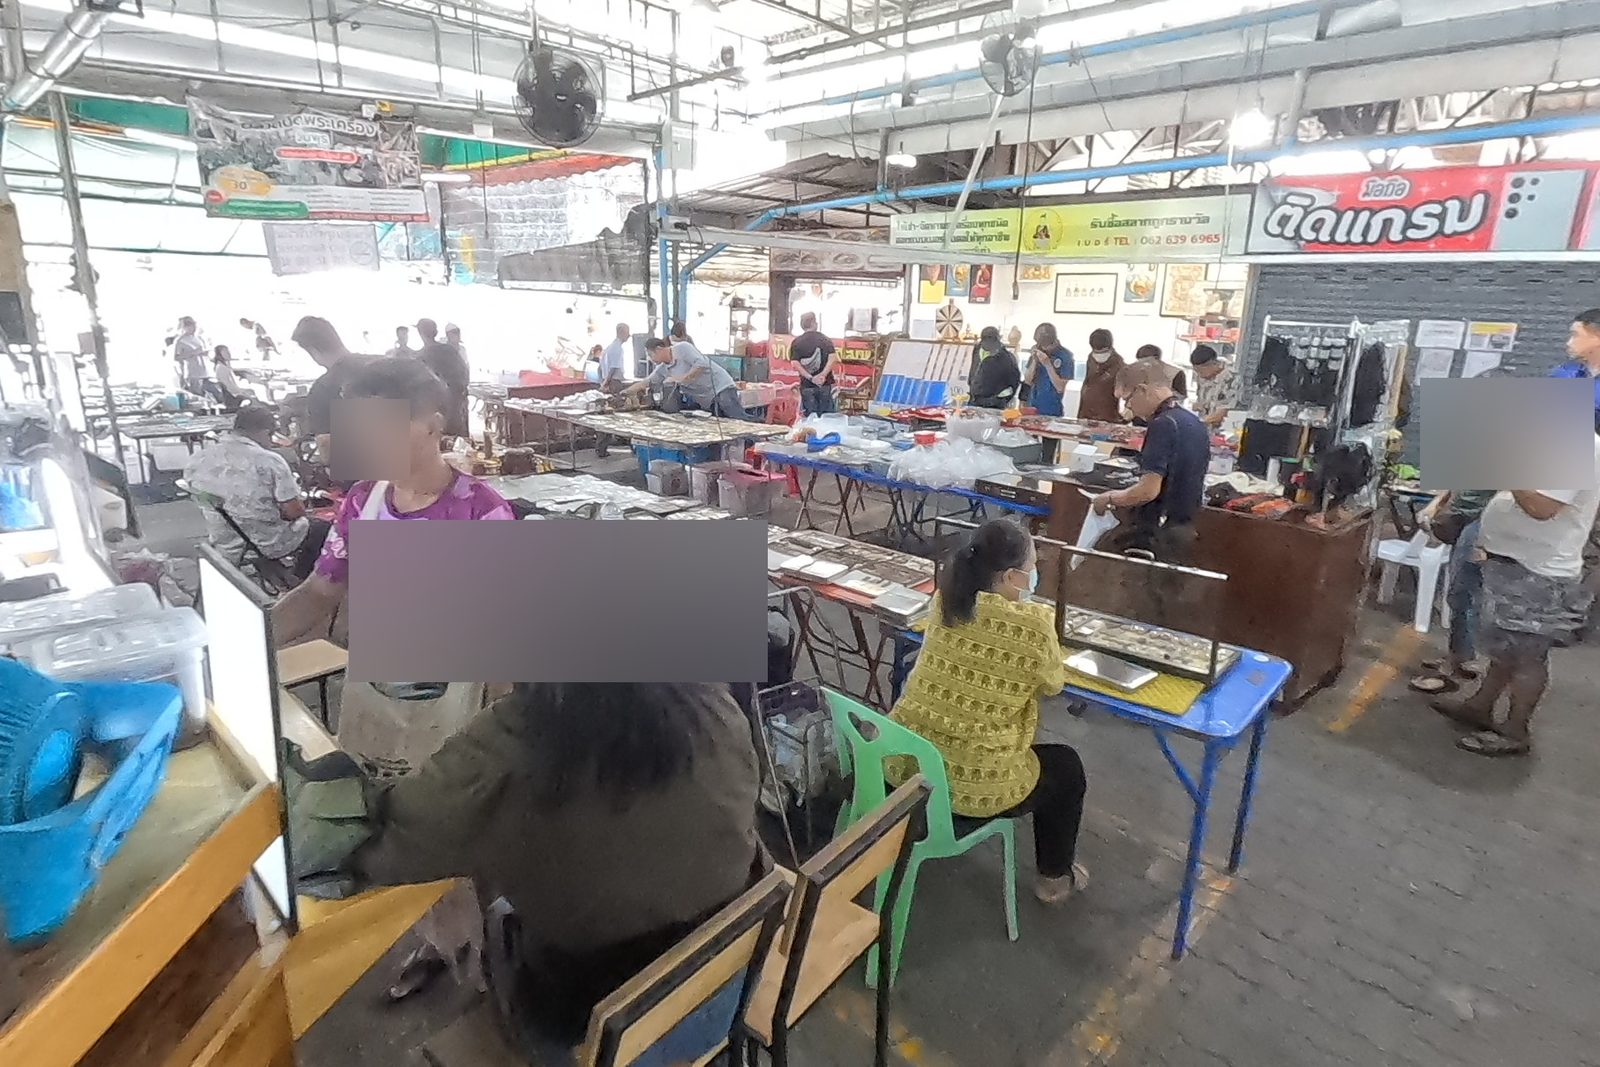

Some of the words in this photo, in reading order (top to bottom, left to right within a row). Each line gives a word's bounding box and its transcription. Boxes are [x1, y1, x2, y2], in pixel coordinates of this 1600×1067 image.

[1362, 178, 1408, 197] มือถือ
[1264, 191, 1489, 244] ติดแกรม
[1113, 237, 1130, 246] TEL
[1191, 233, 1221, 244] 6965
